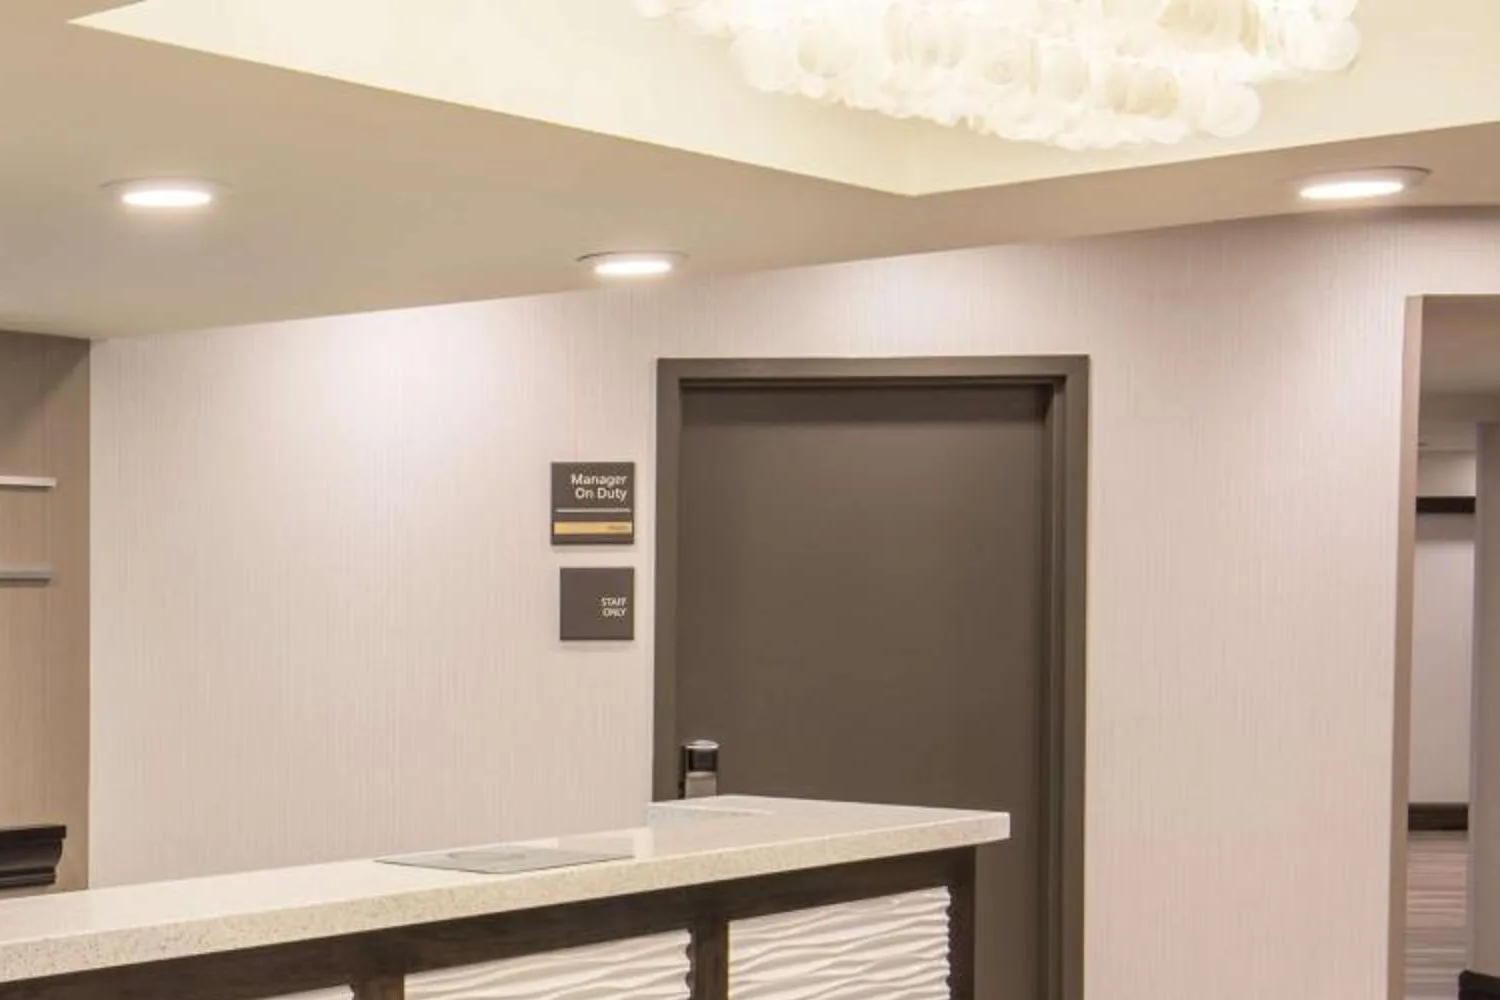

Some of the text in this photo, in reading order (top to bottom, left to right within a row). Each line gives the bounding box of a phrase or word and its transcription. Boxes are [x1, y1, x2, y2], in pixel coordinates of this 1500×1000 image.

[571, 473, 627, 488] Manager
[575, 487, 627, 501] On Duty
